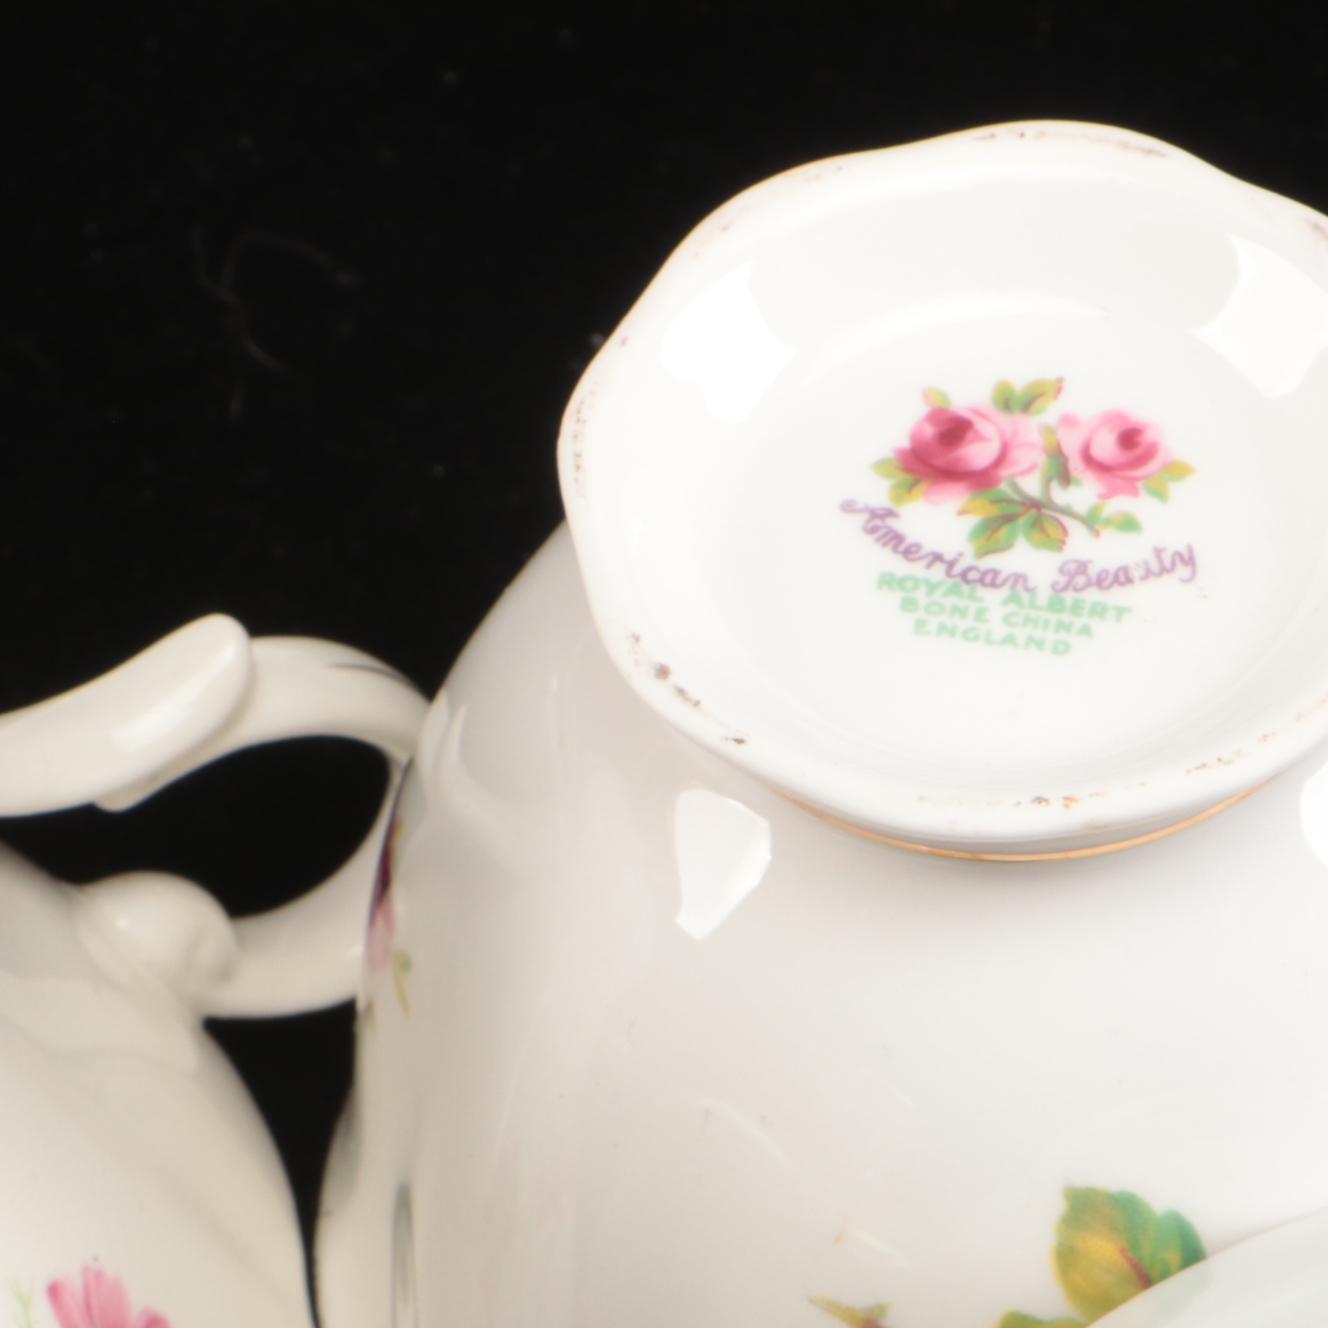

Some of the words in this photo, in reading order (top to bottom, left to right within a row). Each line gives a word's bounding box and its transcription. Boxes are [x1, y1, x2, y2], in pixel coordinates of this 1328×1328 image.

[839, 499, 1038, 593] American
[1051, 543, 1198, 594] Beauty
[877, 571, 986, 603] ROYAL
[1000, 589, 1132, 624] ALBERT
[899, 596, 990, 624] BONE
[1001, 611, 1095, 639] CHINA
[913, 618, 1073, 656] ENGLAND
